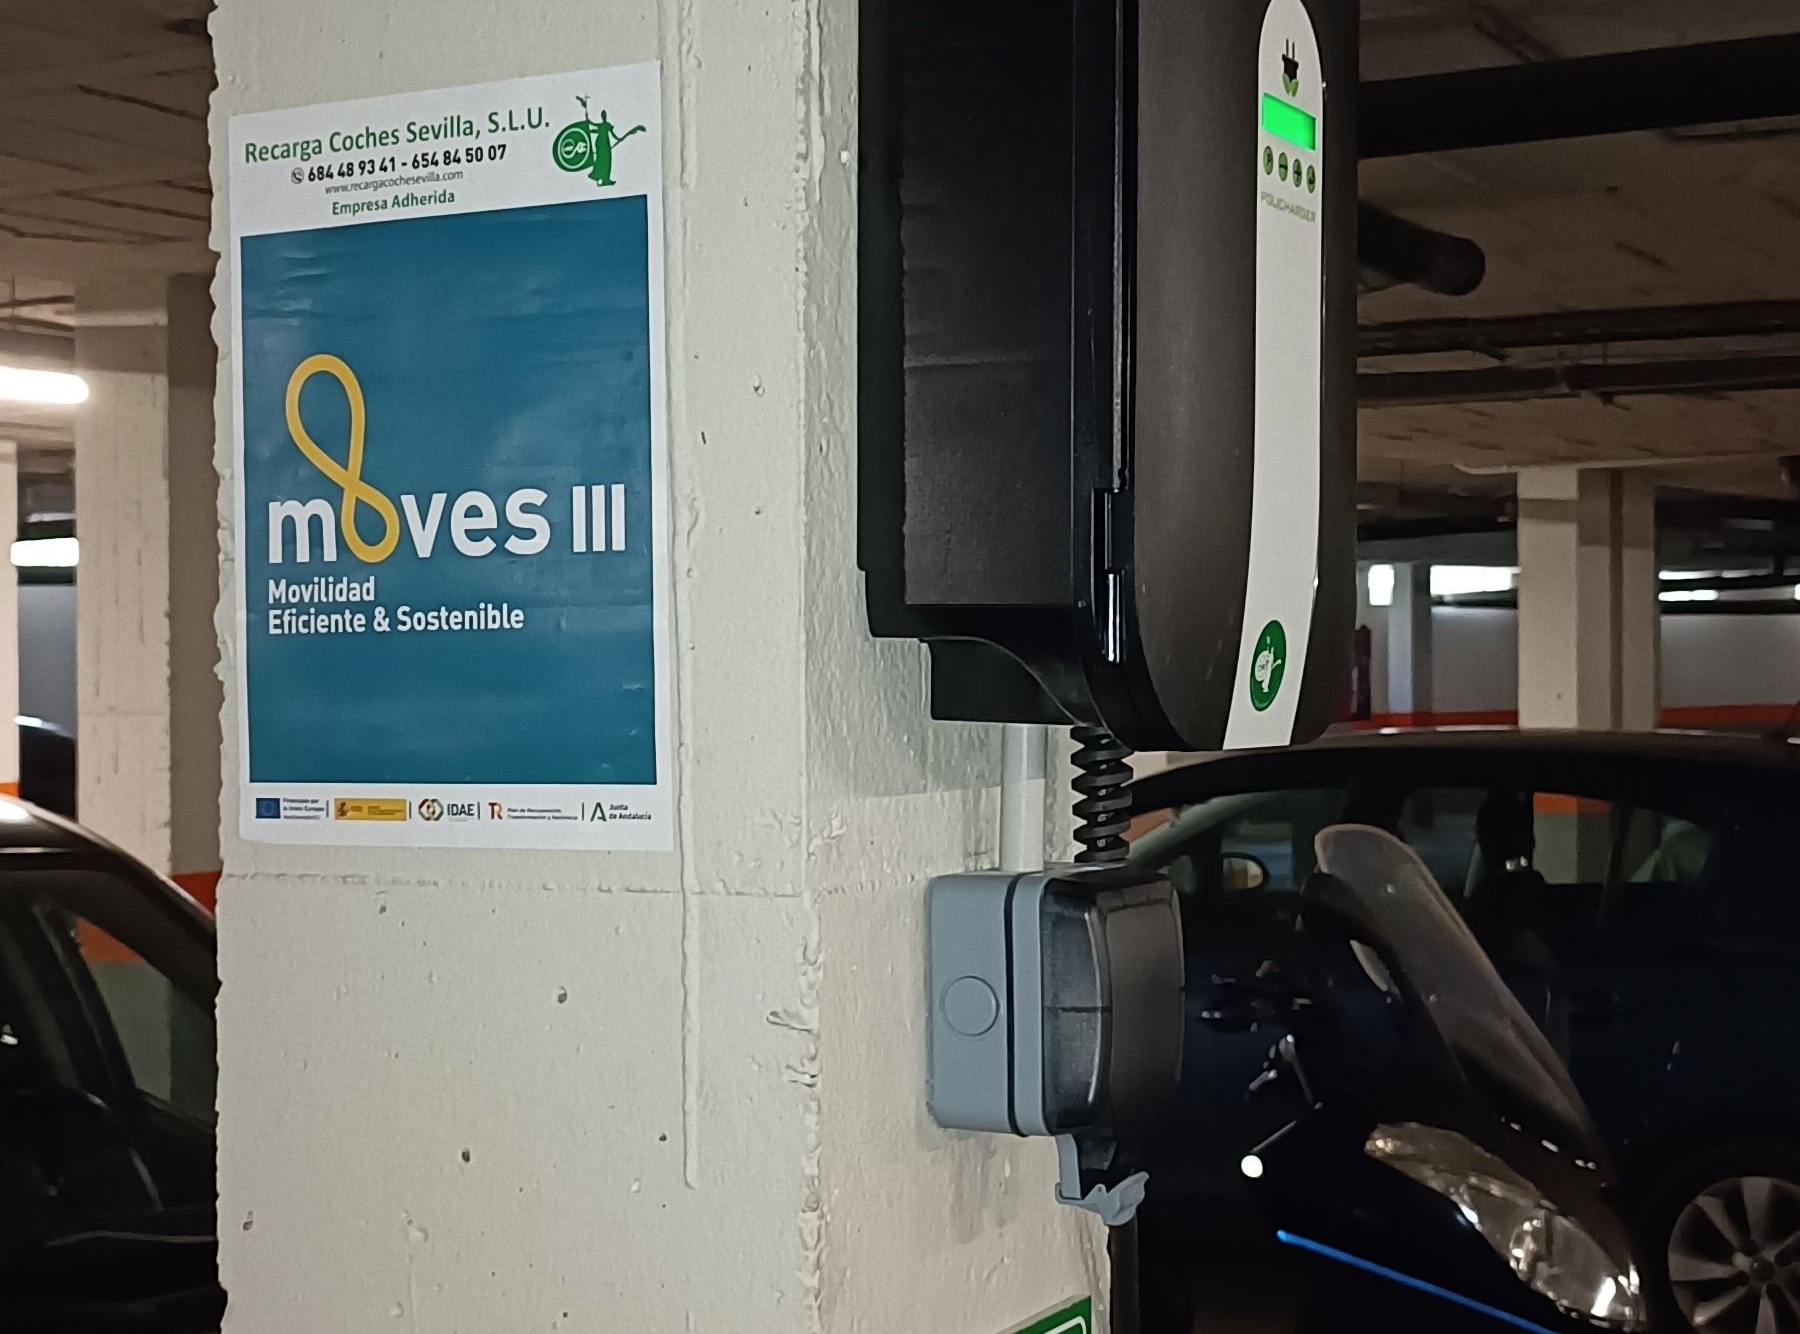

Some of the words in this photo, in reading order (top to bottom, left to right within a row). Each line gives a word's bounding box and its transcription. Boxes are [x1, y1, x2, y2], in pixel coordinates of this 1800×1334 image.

[245, 138, 322, 164] Recarga
[329, 126, 400, 153] Coches
[406, 114, 481, 144] Sevilla,
[488, 106, 550, 134] S.L.U.
[307, 164, 334, 183] 684
[337, 161, 354, 179] 48
[358, 158, 376, 176] 93
[379, 156, 396, 174] 41
[411, 151, 439, 170] 654
[442, 148, 461, 166] 84
[465, 145, 483, 163] 50
[488, 143, 507, 161] 07
[332, 197, 388, 216] Empresa
[391, 188, 455, 209] Adherida
[571, 482, 626, 554] III
[268, 575, 375, 605] Movilidad
[268, 606, 366, 635] Eficiente
[373, 605, 390, 633] &
[396, 602, 525, 632] Sostenible
[447, 803, 475, 817] IDAE
